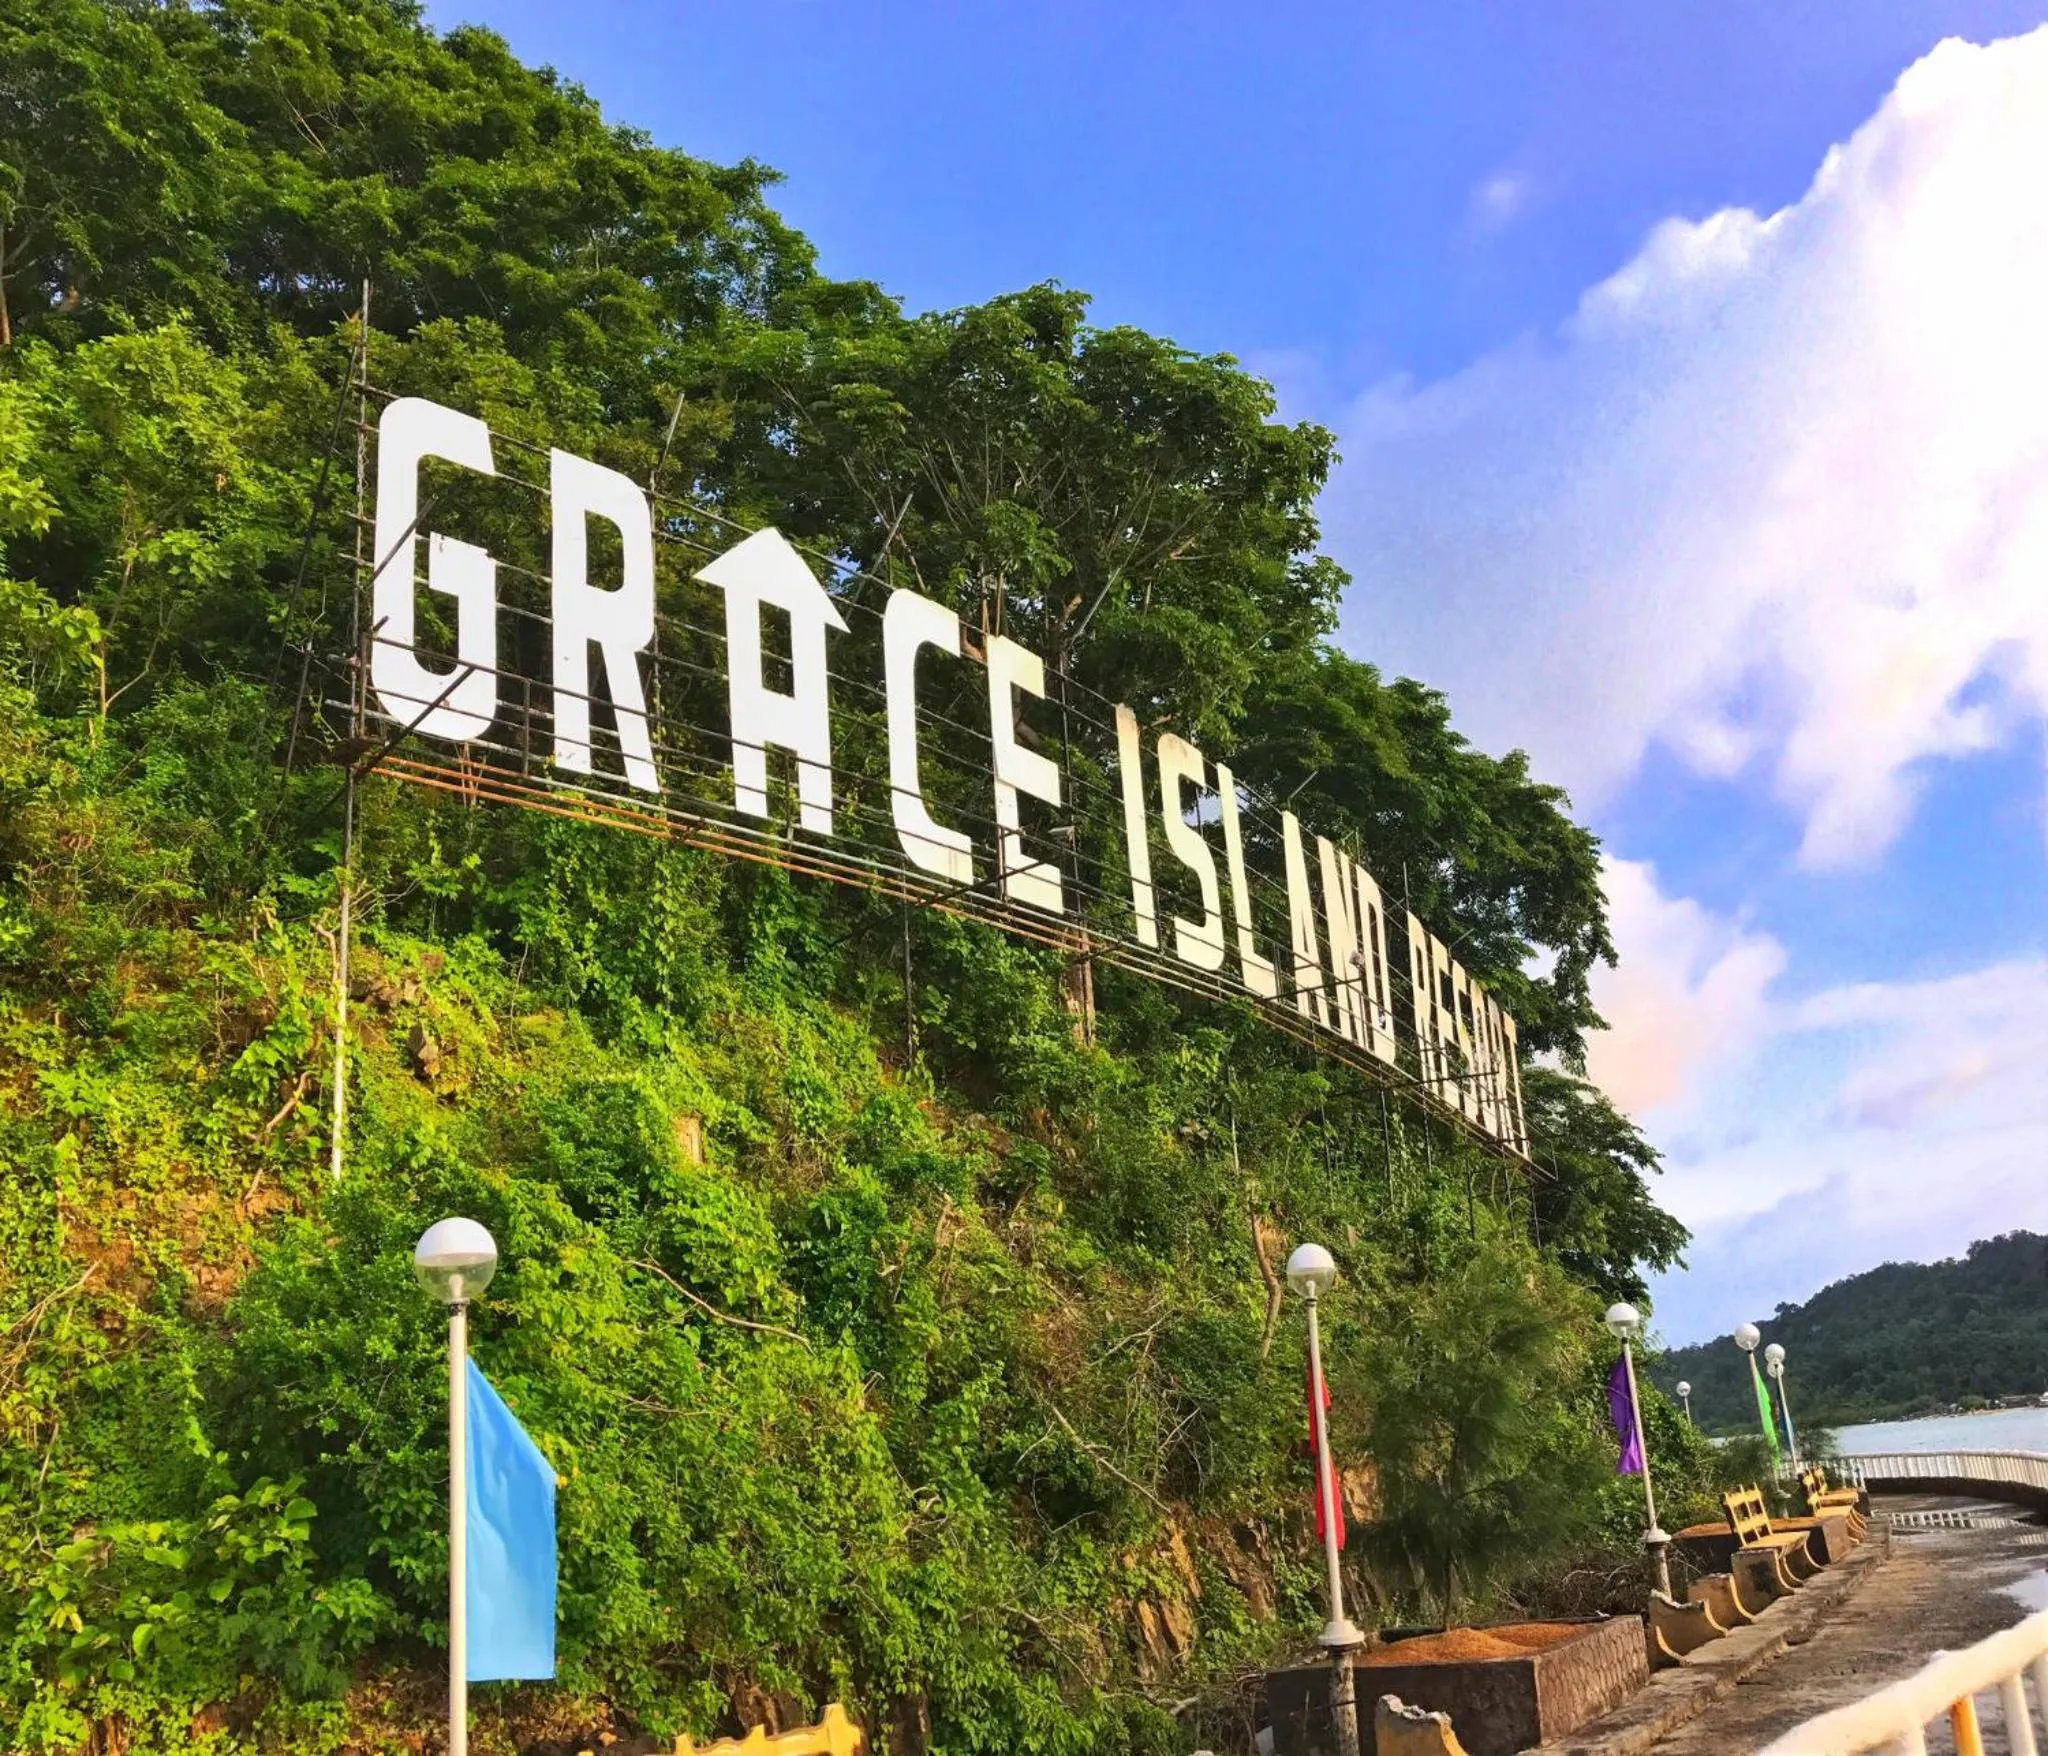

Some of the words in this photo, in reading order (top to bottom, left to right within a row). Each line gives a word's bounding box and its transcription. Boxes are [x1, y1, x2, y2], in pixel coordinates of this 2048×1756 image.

[371, 397, 1064, 915] GRACE
[1115, 703, 1397, 1067] ISLAND
[1407, 910, 1531, 1162] RESORT
